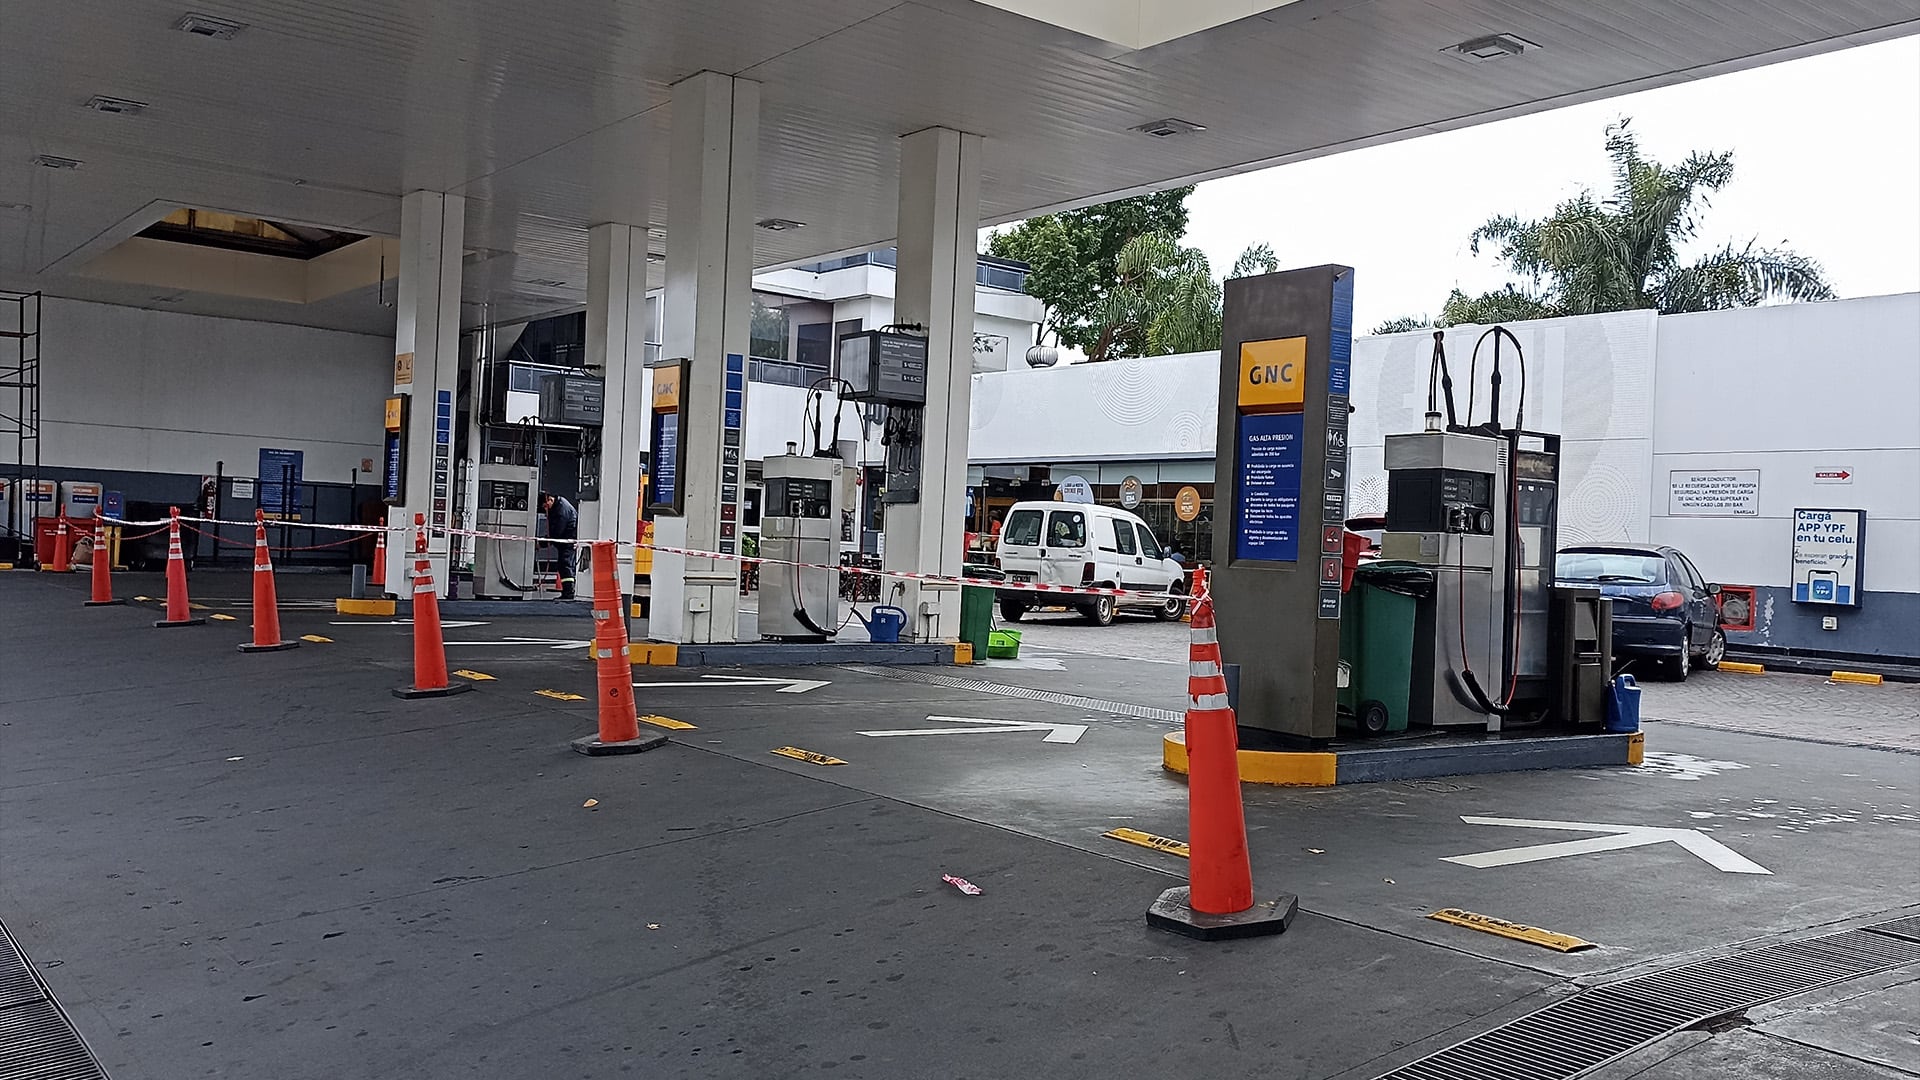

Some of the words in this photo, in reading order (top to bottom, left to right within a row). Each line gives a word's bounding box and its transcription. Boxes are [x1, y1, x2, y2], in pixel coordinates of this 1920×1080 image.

[1249, 363, 1293, 385] GNC
[1798, 510, 1832, 522] Cargá
[1797, 522, 1821, 532] APP
[1824, 523, 1846, 533] YPF
[1814, 535, 1825, 543] tu
[1828, 535, 1855, 544] celu.
